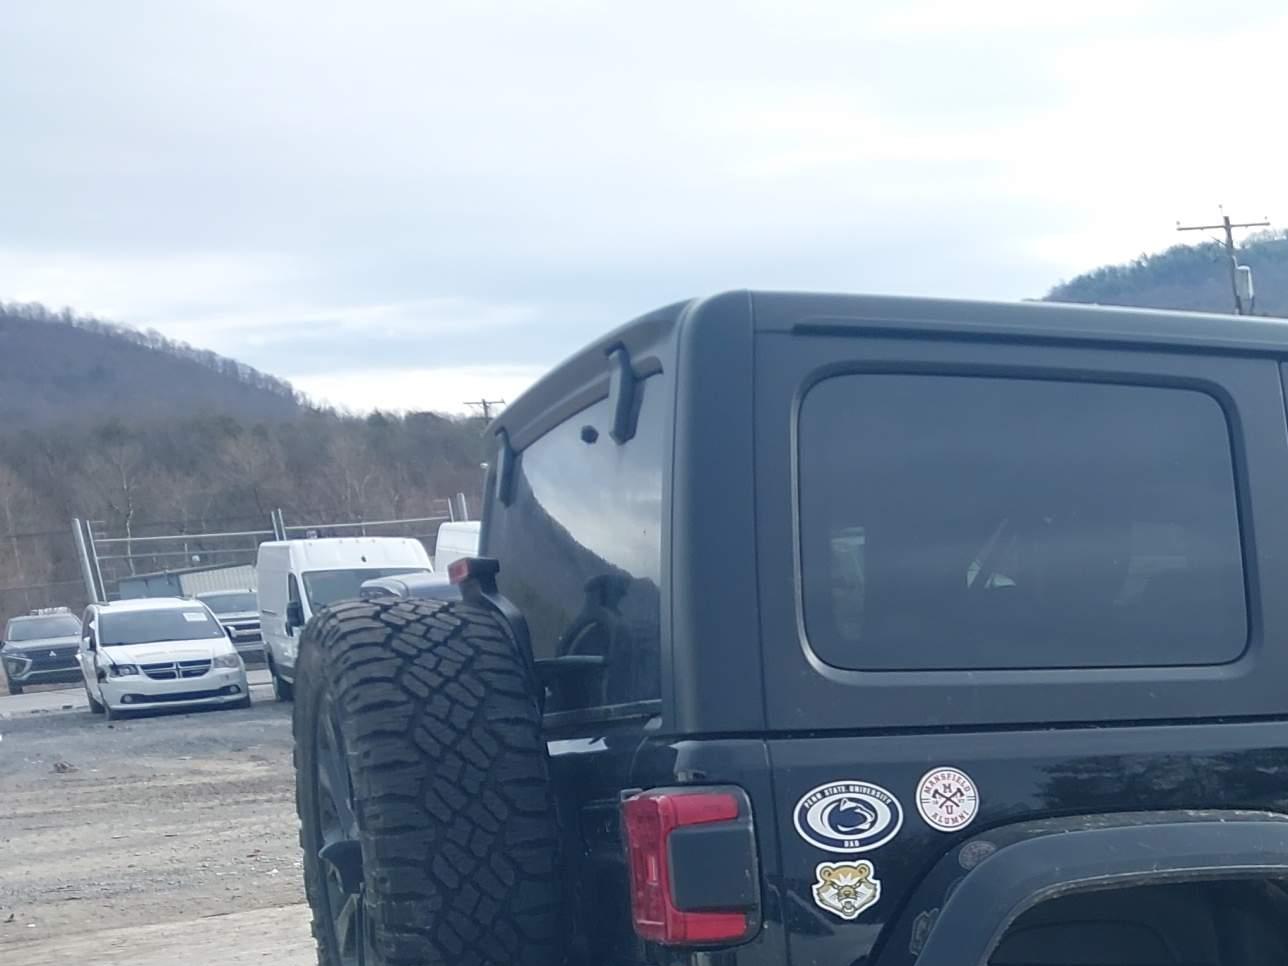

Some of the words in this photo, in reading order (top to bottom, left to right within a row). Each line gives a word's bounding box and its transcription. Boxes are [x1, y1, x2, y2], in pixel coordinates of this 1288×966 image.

[923, 773, 971, 794] MANSFIELD
[803, 793, 823, 809] PENN
[824, 785, 846, 797] STATE
[848, 785, 892, 805] UNIVERSITY
[931, 810, 969, 825] ALUMNI
[945, 805, 954, 815] U
